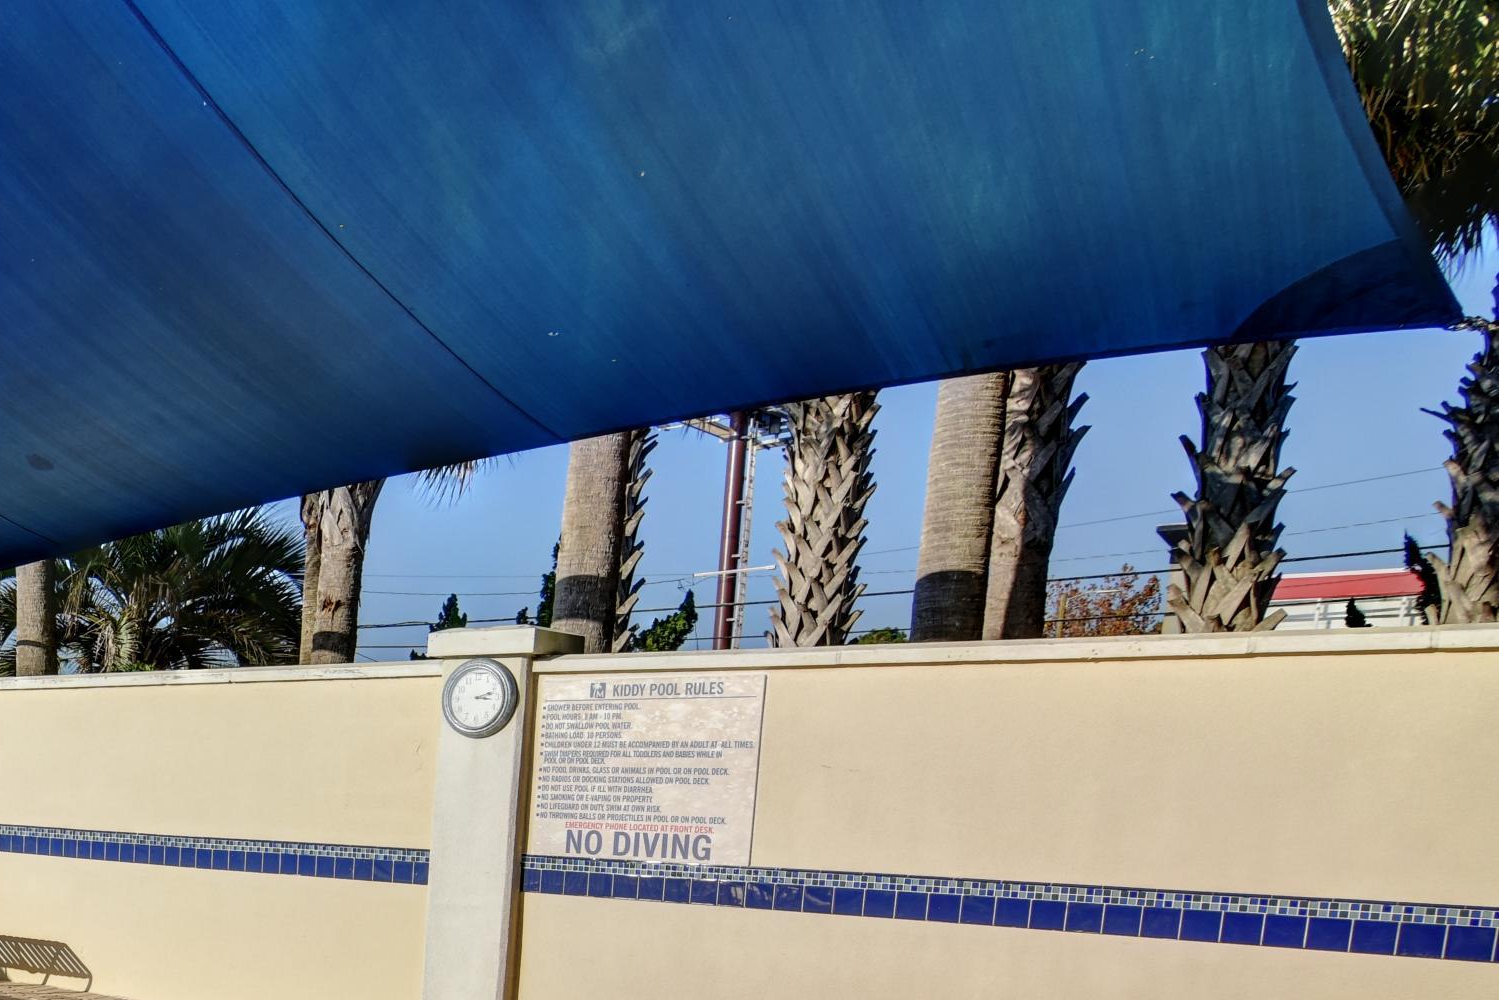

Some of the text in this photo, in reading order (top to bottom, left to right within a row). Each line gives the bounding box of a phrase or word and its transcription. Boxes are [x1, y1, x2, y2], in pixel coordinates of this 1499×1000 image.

[613, 684, 646, 696] KIDDY
[650, 682, 681, 696] POOL
[685, 682, 724, 695] RULES
[607, 814, 644, 822] PROJECTILES
[690, 816, 708, 824] POOL
[566, 830, 712, 860] NO DIVING
